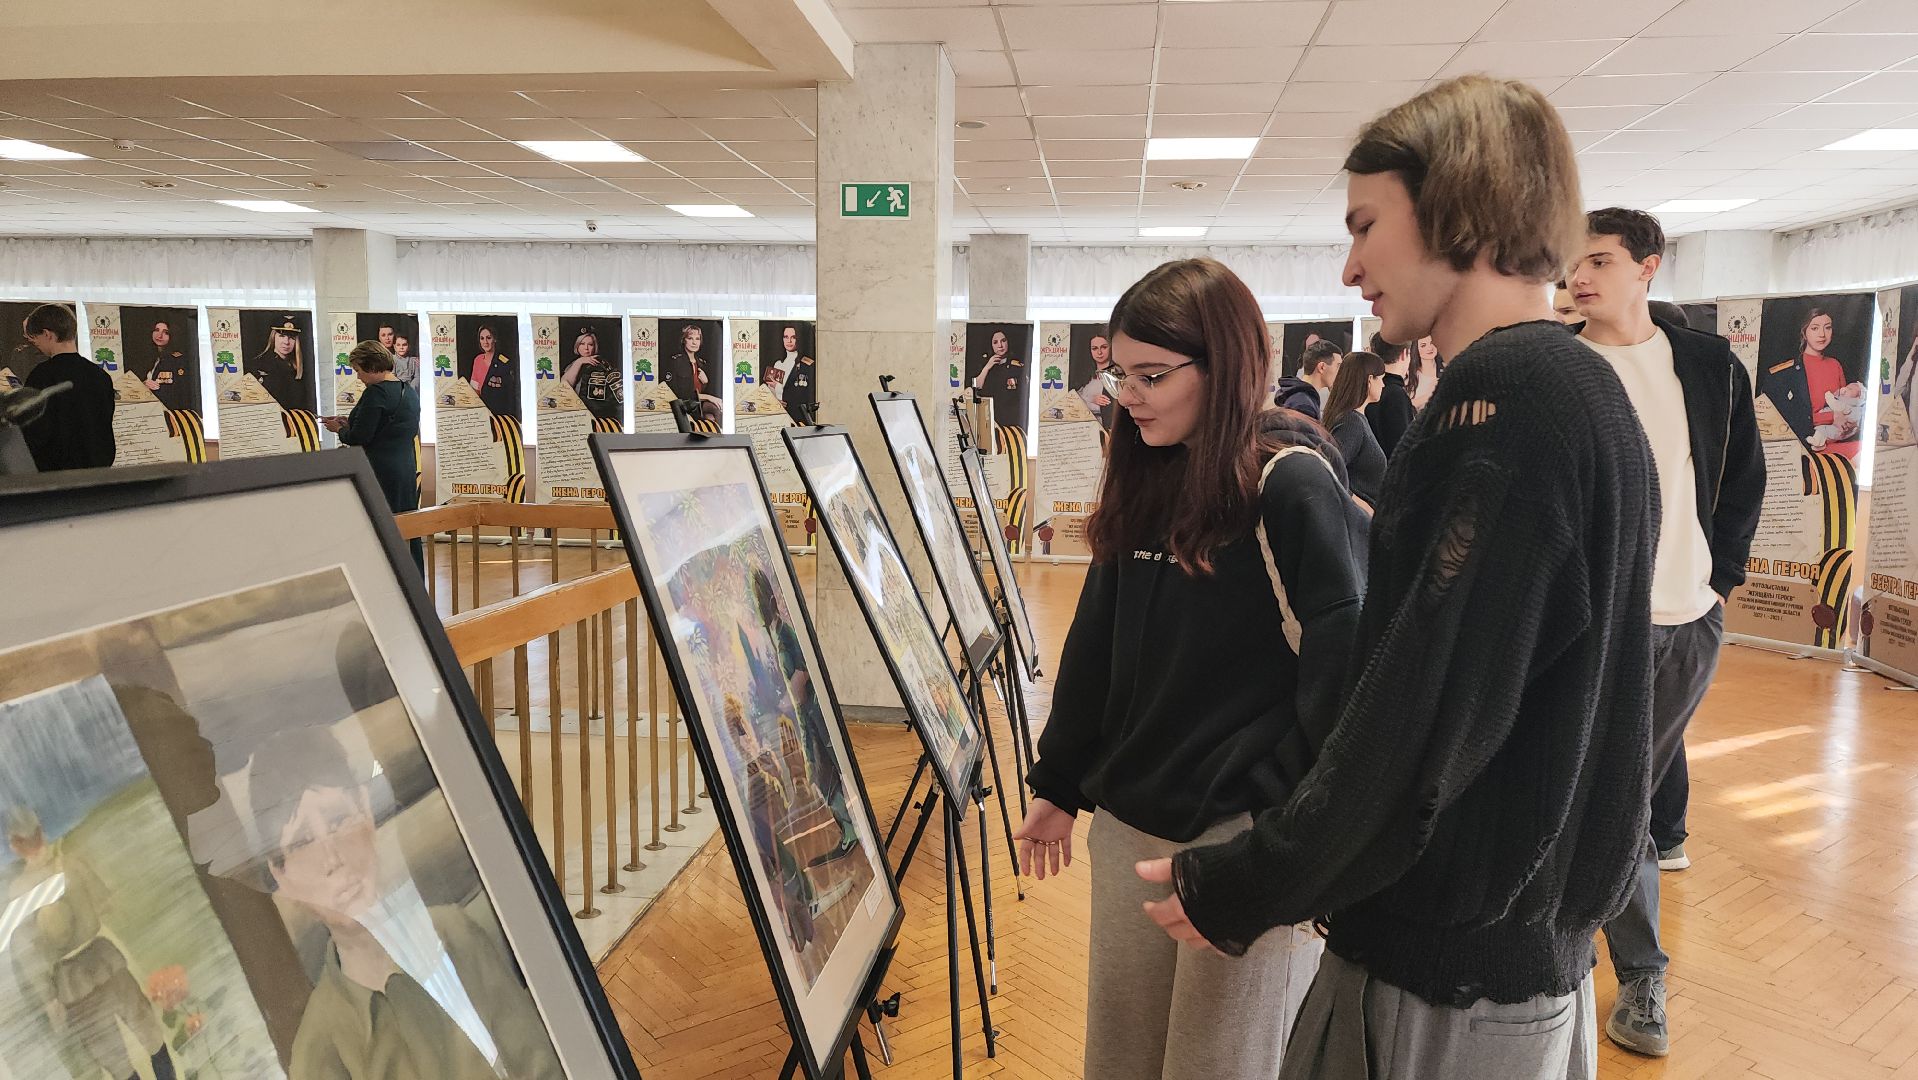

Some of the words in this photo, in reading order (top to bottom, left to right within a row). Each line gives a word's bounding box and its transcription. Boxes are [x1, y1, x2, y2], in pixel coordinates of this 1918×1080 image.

[452, 483, 479, 494] ЖЕНА
[480, 484, 508, 495] ГЕРОЯ
[552, 487, 579, 498] ЖЕНА
[1053, 501, 1082, 512] ЖЕНА
[1744, 557, 1769, 574] ЕНА
[1773, 560, 1821, 580] ГЕРОЯ
[1871, 573, 1902, 597] СЕСТРА
